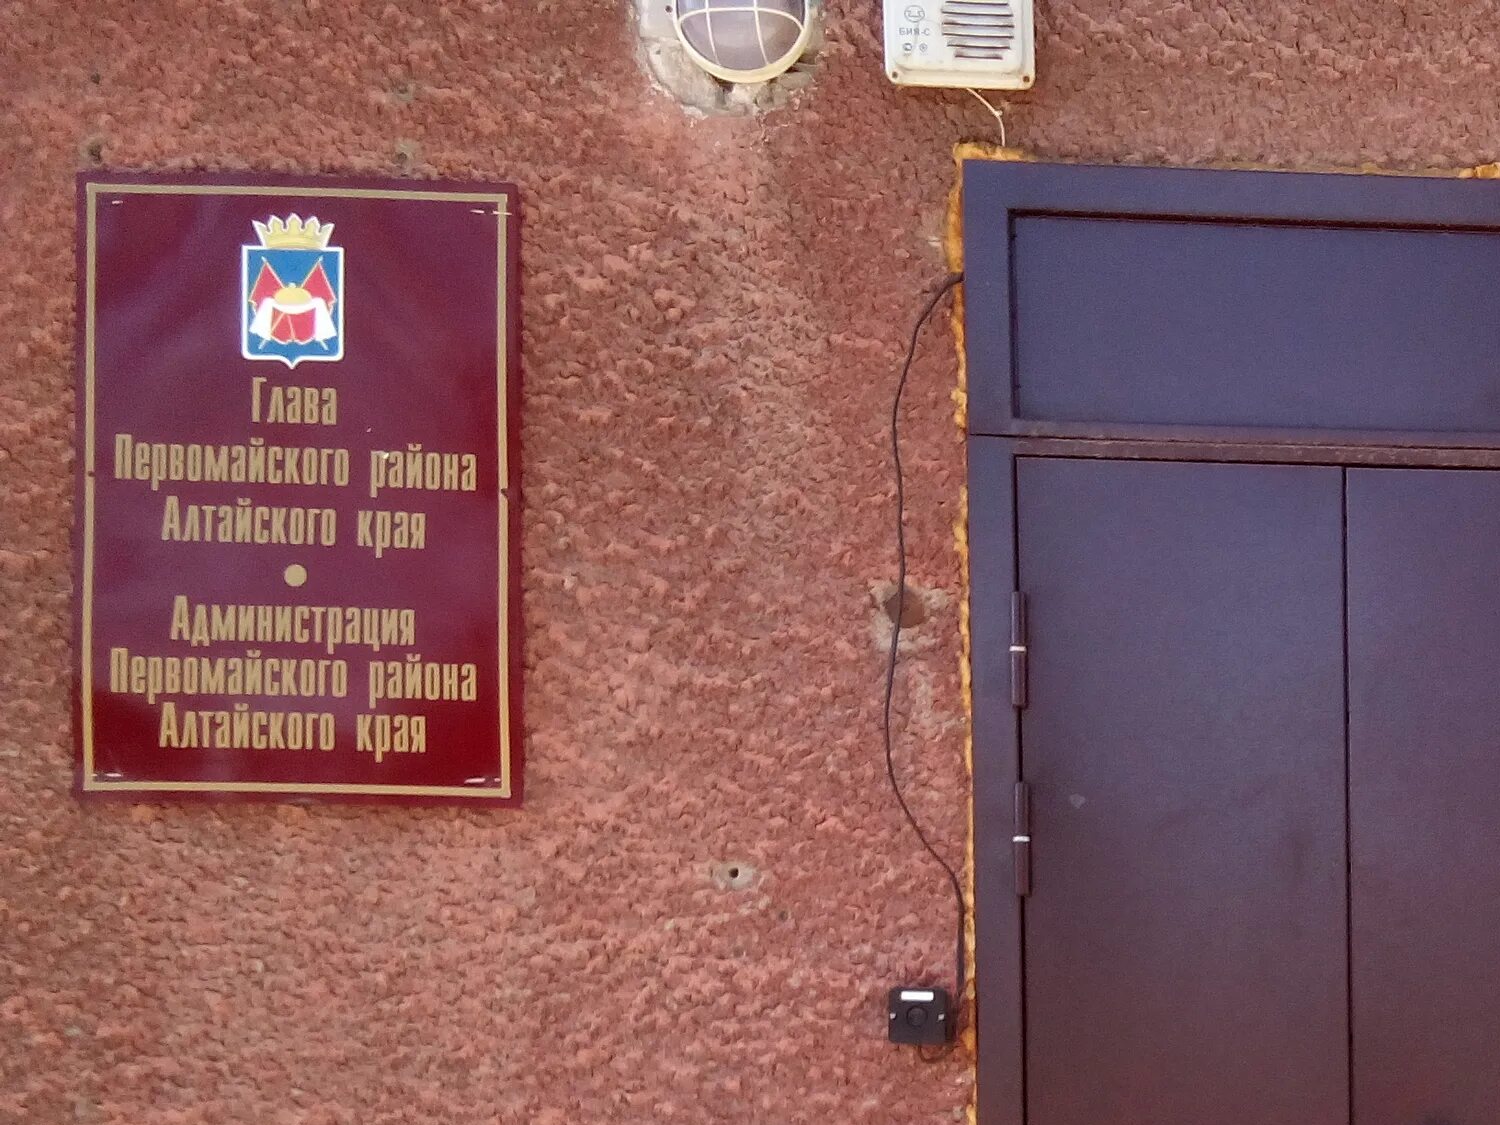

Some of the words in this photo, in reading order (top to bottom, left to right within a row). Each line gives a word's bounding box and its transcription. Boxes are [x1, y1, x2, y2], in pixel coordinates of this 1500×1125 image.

[251, 376, 337, 425] Глава
[114, 433, 349, 491] Первомайского
[370, 443, 477, 498] района
[161, 496, 337, 546] Алтайского
[357, 509, 426, 558] края
[170, 595, 415, 654] Администрация
[110, 647, 347, 704] Первомайского
[369, 653, 477, 708] района
[159, 702, 335, 751] Алтайского
[356, 713, 426, 763] края
